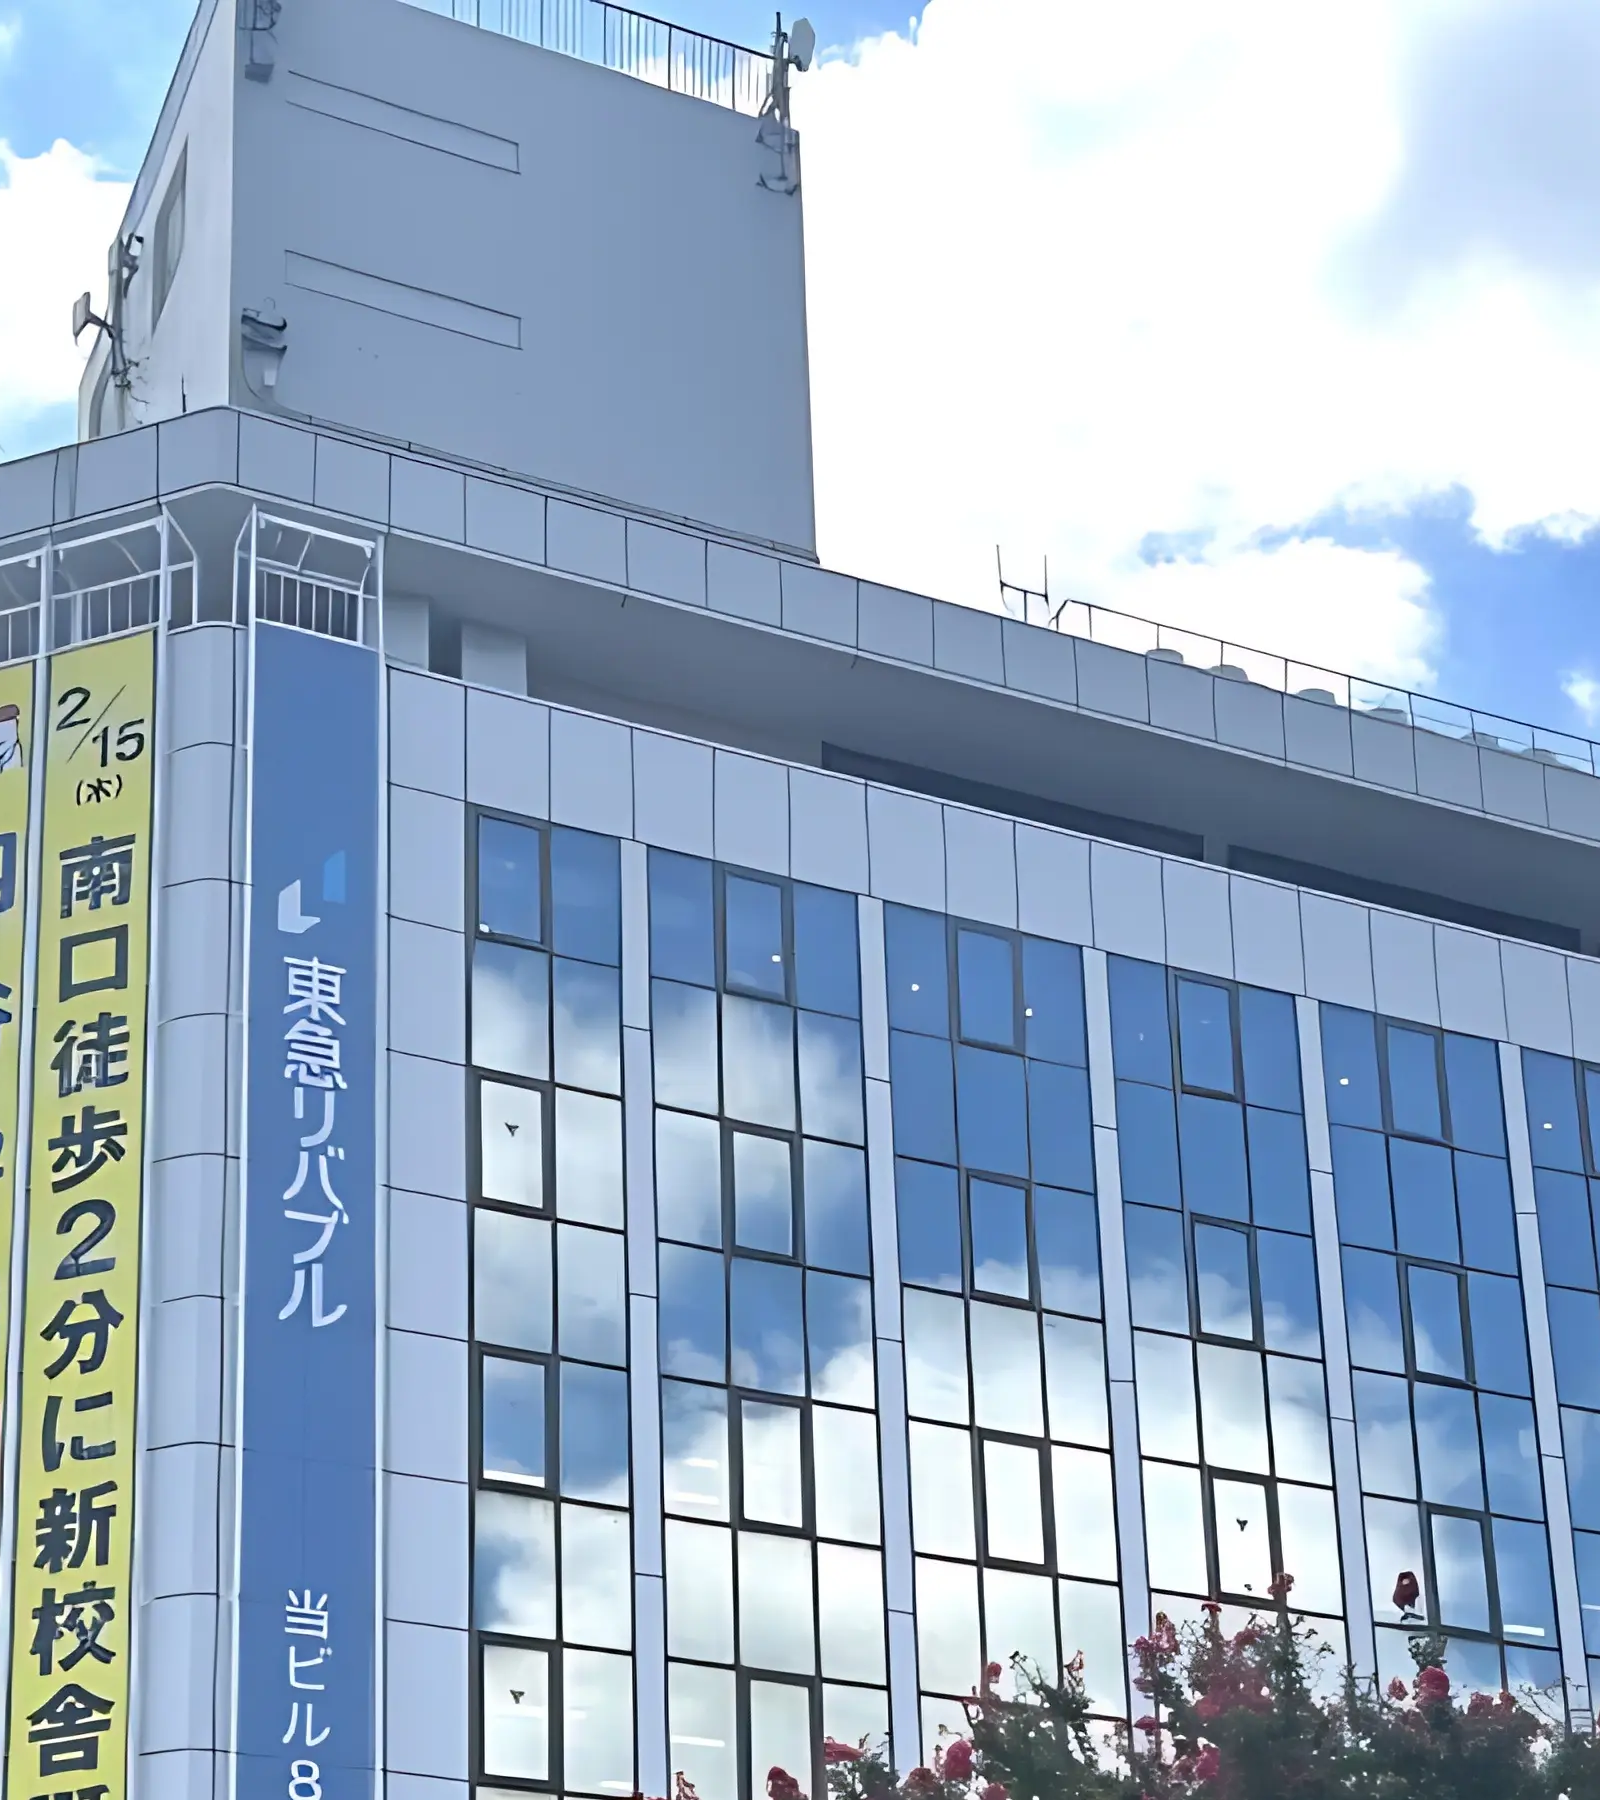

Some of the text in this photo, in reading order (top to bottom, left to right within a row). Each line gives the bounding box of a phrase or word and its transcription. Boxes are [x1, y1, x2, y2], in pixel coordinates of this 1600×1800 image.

[278, 955, 350, 1329] 東急リバブル
